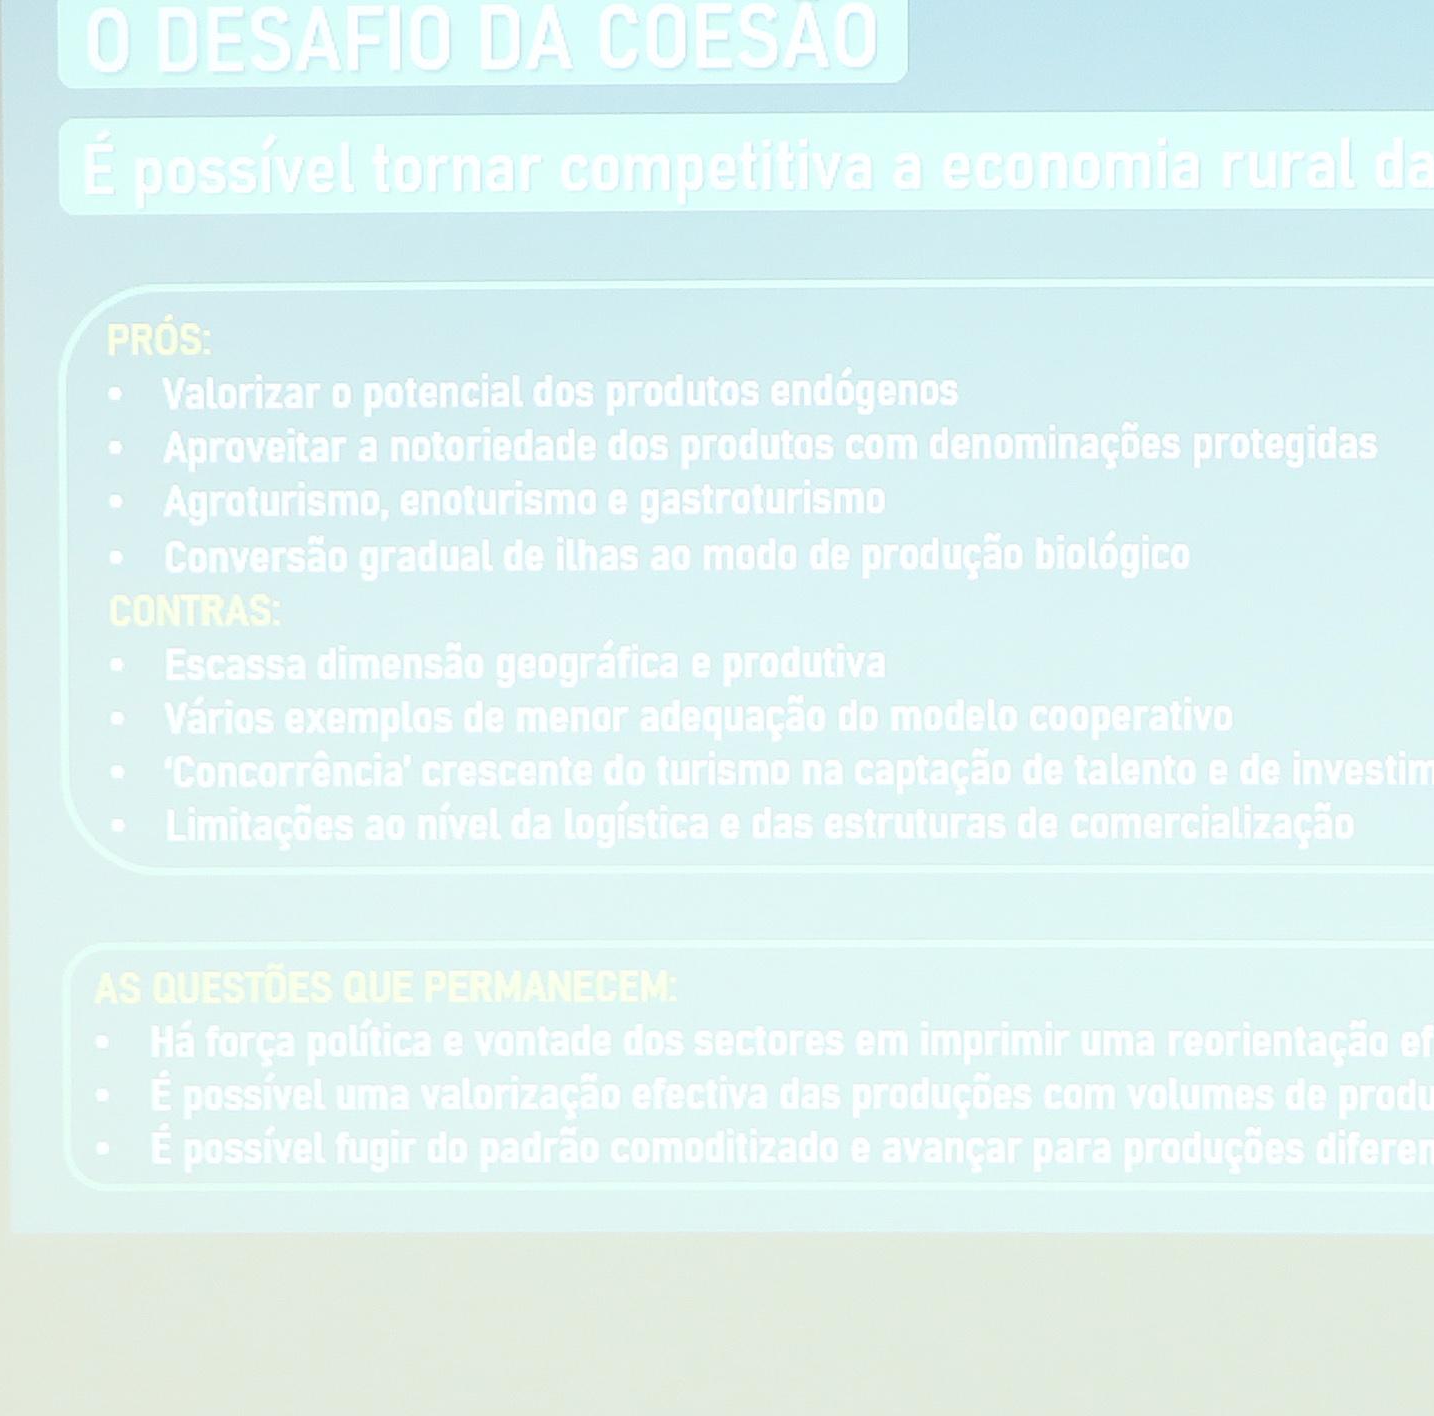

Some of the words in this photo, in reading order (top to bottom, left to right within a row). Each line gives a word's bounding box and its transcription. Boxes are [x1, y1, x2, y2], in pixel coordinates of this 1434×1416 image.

[88, 8, 128, 72] O
[160, 5, 449, 71] DESAFIO
[481, 4, 573, 69] DA
[86, 131, 113, 194] É
[137, 135, 353, 208] possível
[373, 144, 541, 192] tornar
[562, 139, 870, 204] competitiva
[894, 154, 920, 188] a
[944, 138, 1198, 188] economia
[1224, 138, 1354, 187] rural
[1377, 138, 1434, 187] da
[108, 313, 212, 356] PRÓS:
[162, 374, 321, 410] Valorizar
[332, 383, 351, 408] o
[364, 373, 524, 417] potencial
[533, 375, 593, 407] dos
[606, 374, 759, 416] produtos
[771, 368, 959, 415] endógenos
[164, 428, 347, 472] Aproveitar
[358, 437, 377, 464] a
[391, 427, 597, 463] notoriedade
[608, 429, 669, 462] dos
[681, 428, 834, 470] produtos
[846, 434, 917, 460] com
[929, 421, 1181, 470] denominações
[1194, 424, 1378, 469] protegidas
[164, 481, 389, 527] Agroturismo,
[400, 480, 596, 517] enoturismo
[608, 489, 627, 515] e
[641, 479, 885, 524] gastroturismo
[165, 535, 347, 573] Conversão
[359, 539, 493, 581] gradual
[504, 539, 545, 571] de
[557, 536, 638, 571] ilhas
[650, 545, 691, 571] ao
[704, 538, 797, 571] modo
[809, 538, 850, 570] de
[862, 532, 1023, 581] produção
[1035, 530, 1189, 579] biológico
[110, 593, 280, 627] CONTRAS:
[166, 648, 306, 681] Escassa
[318, 642, 484, 680] dimensão
[497, 639, 678, 688] geográfica
[692, 652, 710, 678] e
[724, 643, 885, 687] produtiva
[165, 696, 274, 735] Vários
[285, 701, 453, 742] exemplos
[464, 701, 504, 734] de
[517, 706, 629, 735] menor
[640, 695, 826, 742] adequação
[839, 699, 878, 733] do
[891, 698, 1017, 732] modelo
[1030, 696, 1233, 740] cooperativo
[422, 756, 592, 787] crescente
[604, 753, 645, 785] do
[656, 751, 790, 785] turismo
[803, 760, 843, 785] na
[855, 748, 1011, 795] captação
[1023, 753, 1063, 785] de
[1074, 752, 1196, 785] talento
[1209, 759, 1228, 785] e
[1240, 753, 1280, 785] de
[167, 804, 353, 850] Limitações
[365, 815, 405, 840] ao
[418, 801, 501, 840] nível
[511, 808, 551, 839] da
[565, 800, 709, 848] logística
[720, 813, 740, 839] e
[753, 807, 813, 839] das
[825, 809, 1007, 839] estruturas
[1018, 806, 1057, 839] de
[1070, 802, 1354, 849] comercialização
[96, 971, 140, 1005] AS
[153, 963, 333, 1004] QUESTÕES
[344, 971, 414, 1004] QUE
[425, 970, 677, 1003] PERMANECEM:
[151, 1020, 194, 1057] Há
[205, 1025, 294, 1067] força
[308, 1018, 431, 1066] política
[444, 1031, 463, 1056] e
[475, 1024, 611, 1056] vontade
[624, 1024, 685, 1056] dos
[694, 1026, 844, 1056] sectores
[856, 1030, 908, 1056] em
[921, 1021, 1070, 1066] imprimir
[1082, 1031, 1154, 1056] uma
[1168, 1021, 1388, 1068] reorientação
[152, 1071, 171, 1111] É
[184, 1072, 326, 1119] possível
[337, 1085, 409, 1110] uma
[421, 1073, 620, 1120] valorização
[633, 1075, 767, 1110] efectiva
[780, 1077, 841, 1109] das
[853, 1072, 1032, 1120] produções
[1044, 1083, 1115, 1110] com
[1127, 1077, 1274, 1110] volumes
[1285, 1078, 1326, 1111] de
[152, 1124, 171, 1164] É
[185, 1126, 325, 1173] possível
[336, 1129, 416, 1172] fugir
[428, 1131, 468, 1163] do
[481, 1126, 599, 1172] padrão
[611, 1128, 838, 1163] comoditizado
[851, 1137, 870, 1163] e
[882, 1137, 1023, 1173] avançar
[1034, 1137, 1111, 1172] para
[1124, 1128, 1305, 1174] produções
